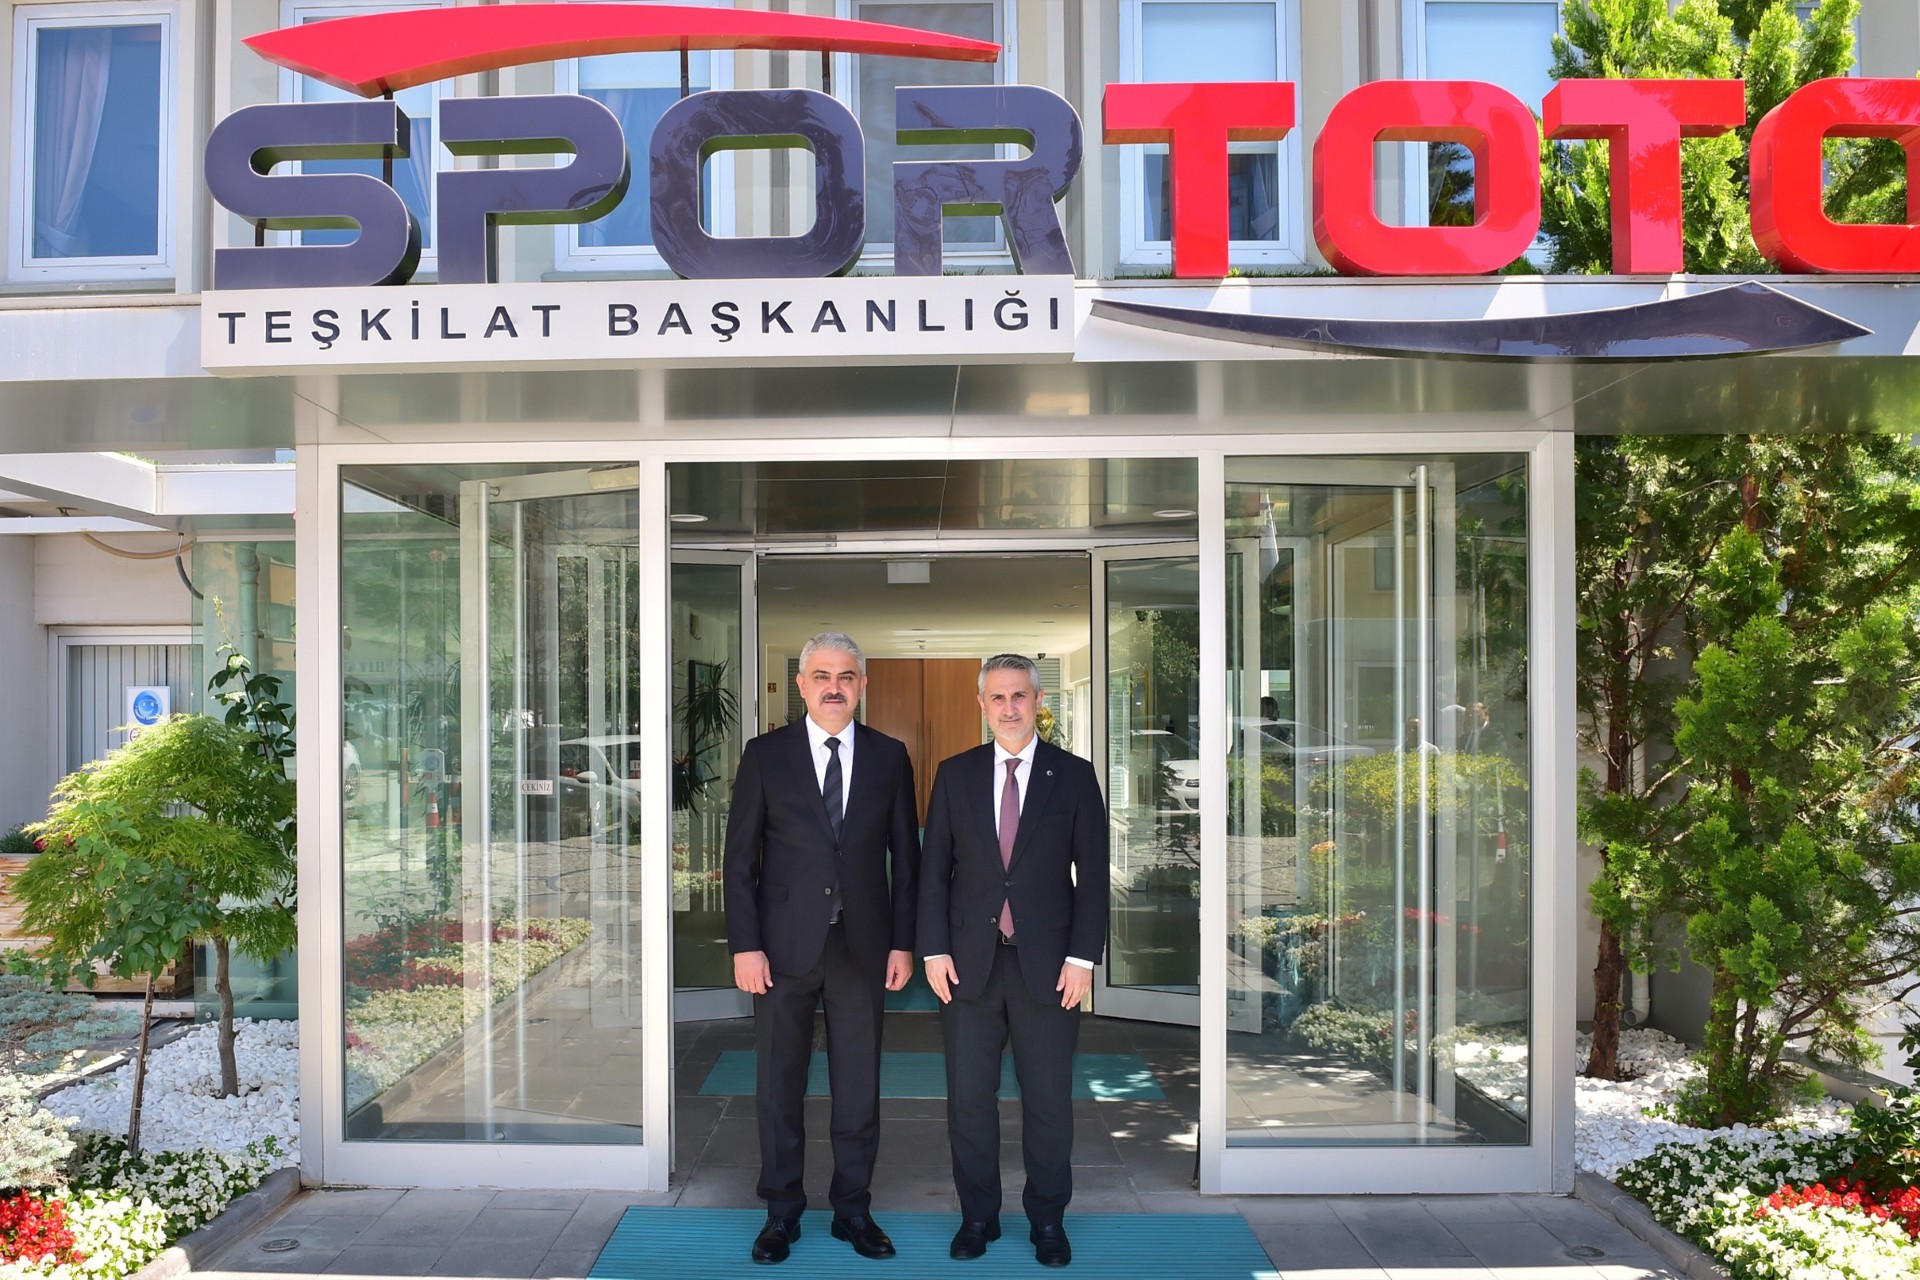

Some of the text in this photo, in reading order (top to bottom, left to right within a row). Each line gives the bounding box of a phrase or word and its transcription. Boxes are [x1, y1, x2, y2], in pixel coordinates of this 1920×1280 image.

[204, 78, 1920, 287] SPOR TOTO
[218, 290, 1058, 350] TEŞKİLAT BAŞKANLIĞI
